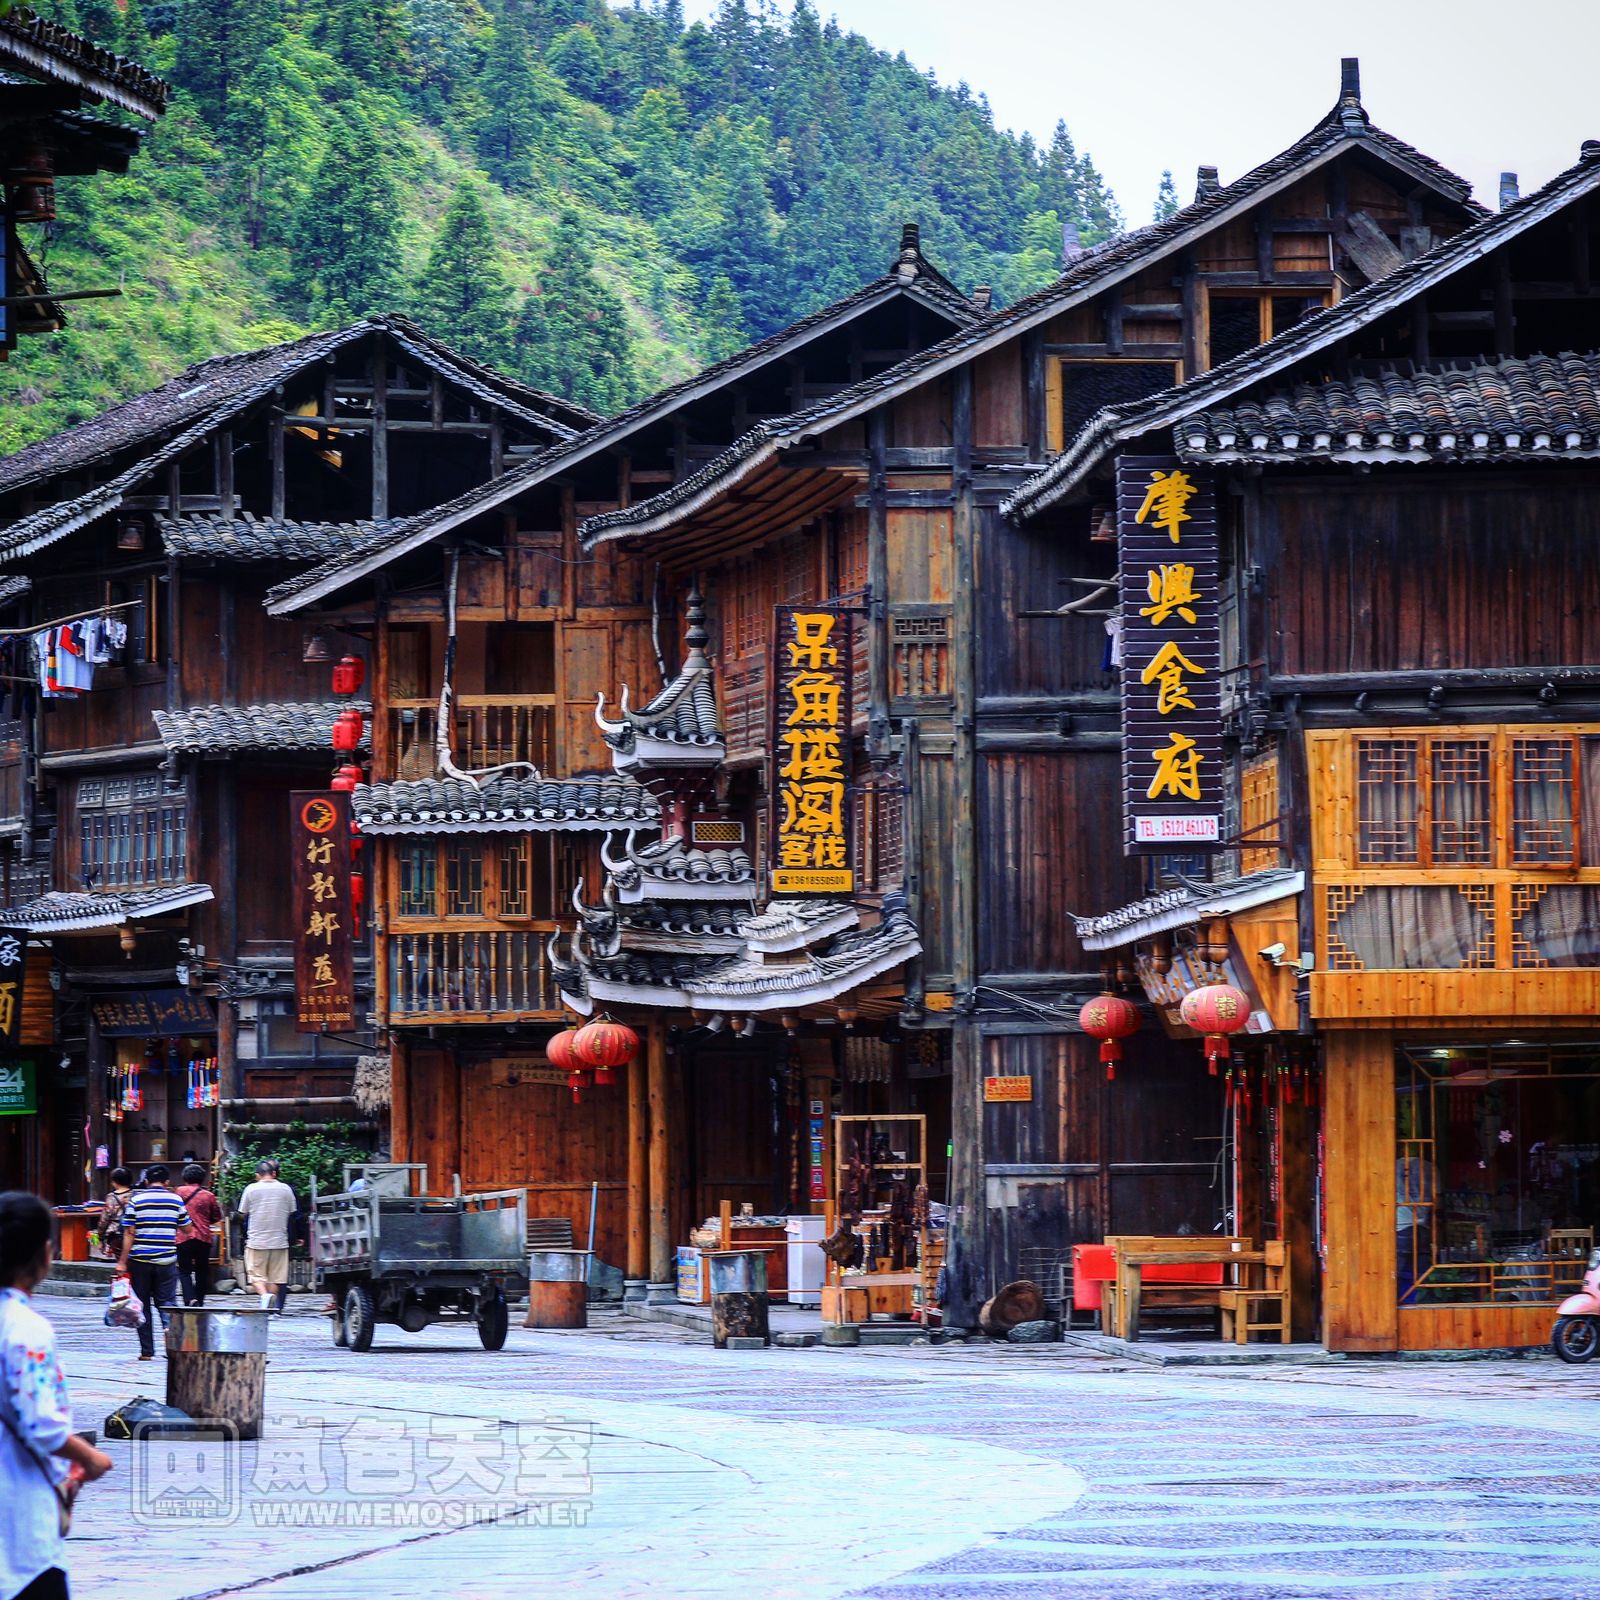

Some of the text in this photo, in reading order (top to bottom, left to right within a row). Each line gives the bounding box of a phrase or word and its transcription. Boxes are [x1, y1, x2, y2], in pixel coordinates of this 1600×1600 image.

[779, 612, 845, 835] 吊角楼阁
[1136, 470, 1206, 801] 肇興食府
[778, 834, 847, 867] 客栈
